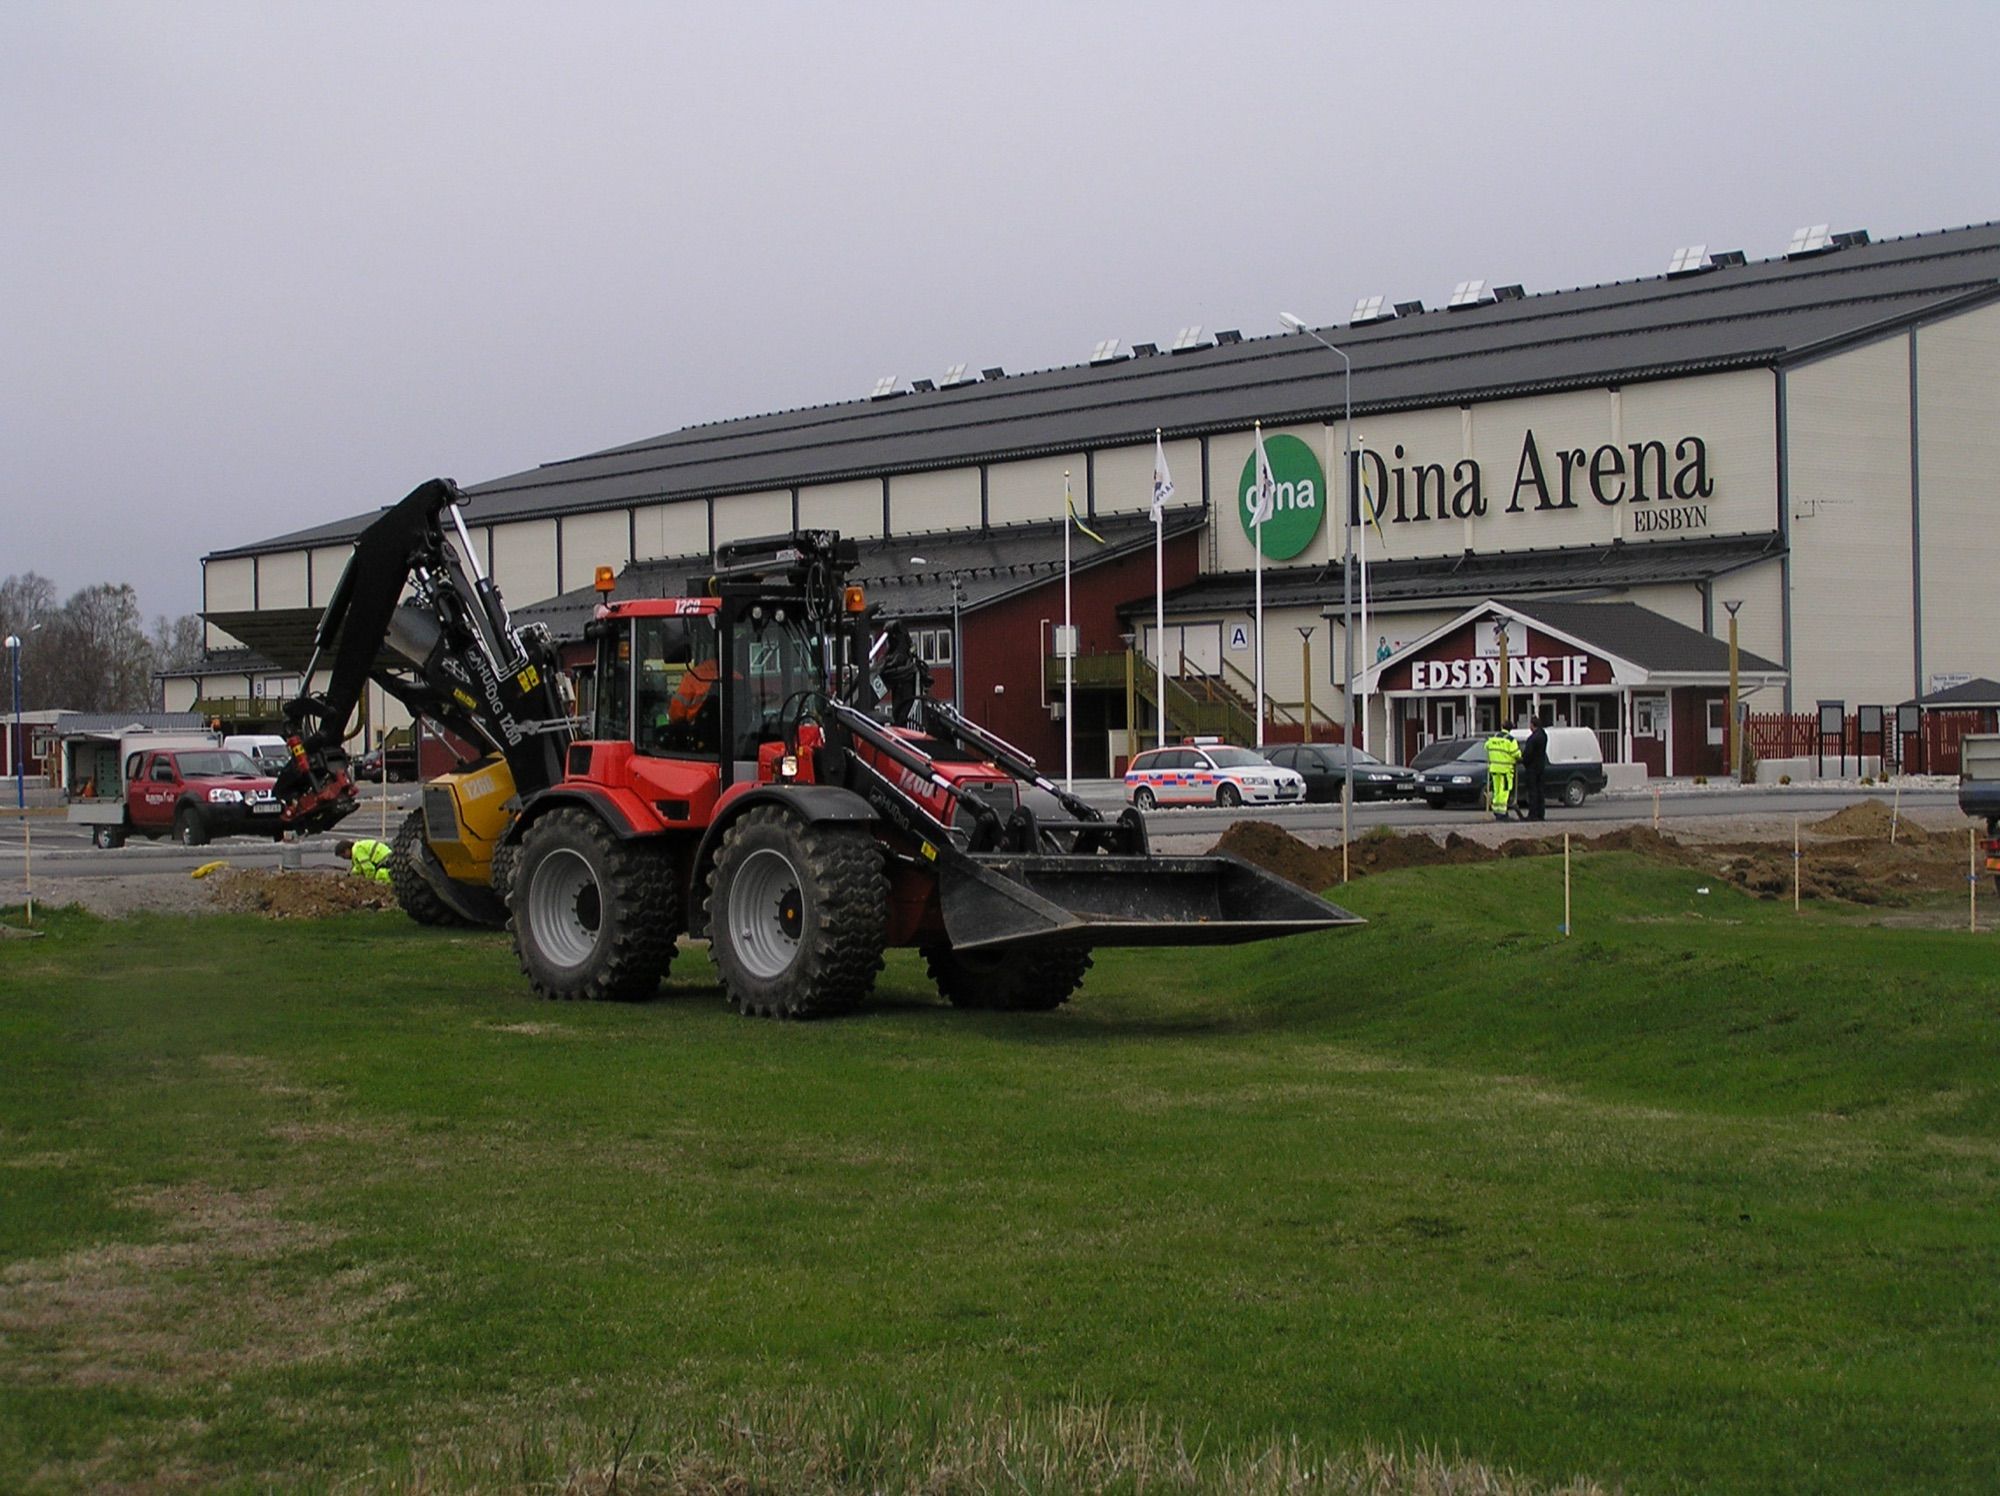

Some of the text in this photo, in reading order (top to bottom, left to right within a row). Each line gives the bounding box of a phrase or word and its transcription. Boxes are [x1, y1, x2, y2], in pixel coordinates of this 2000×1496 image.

[1344, 429, 1714, 527] Dina Arena
[1634, 505, 1707, 532] EDSBYN
[675, 599, 701, 614] 1260
[1232, 628, 1246, 645] A
[1563, 656, 1588, 686] IF
[500, 712, 522, 747] 1260
